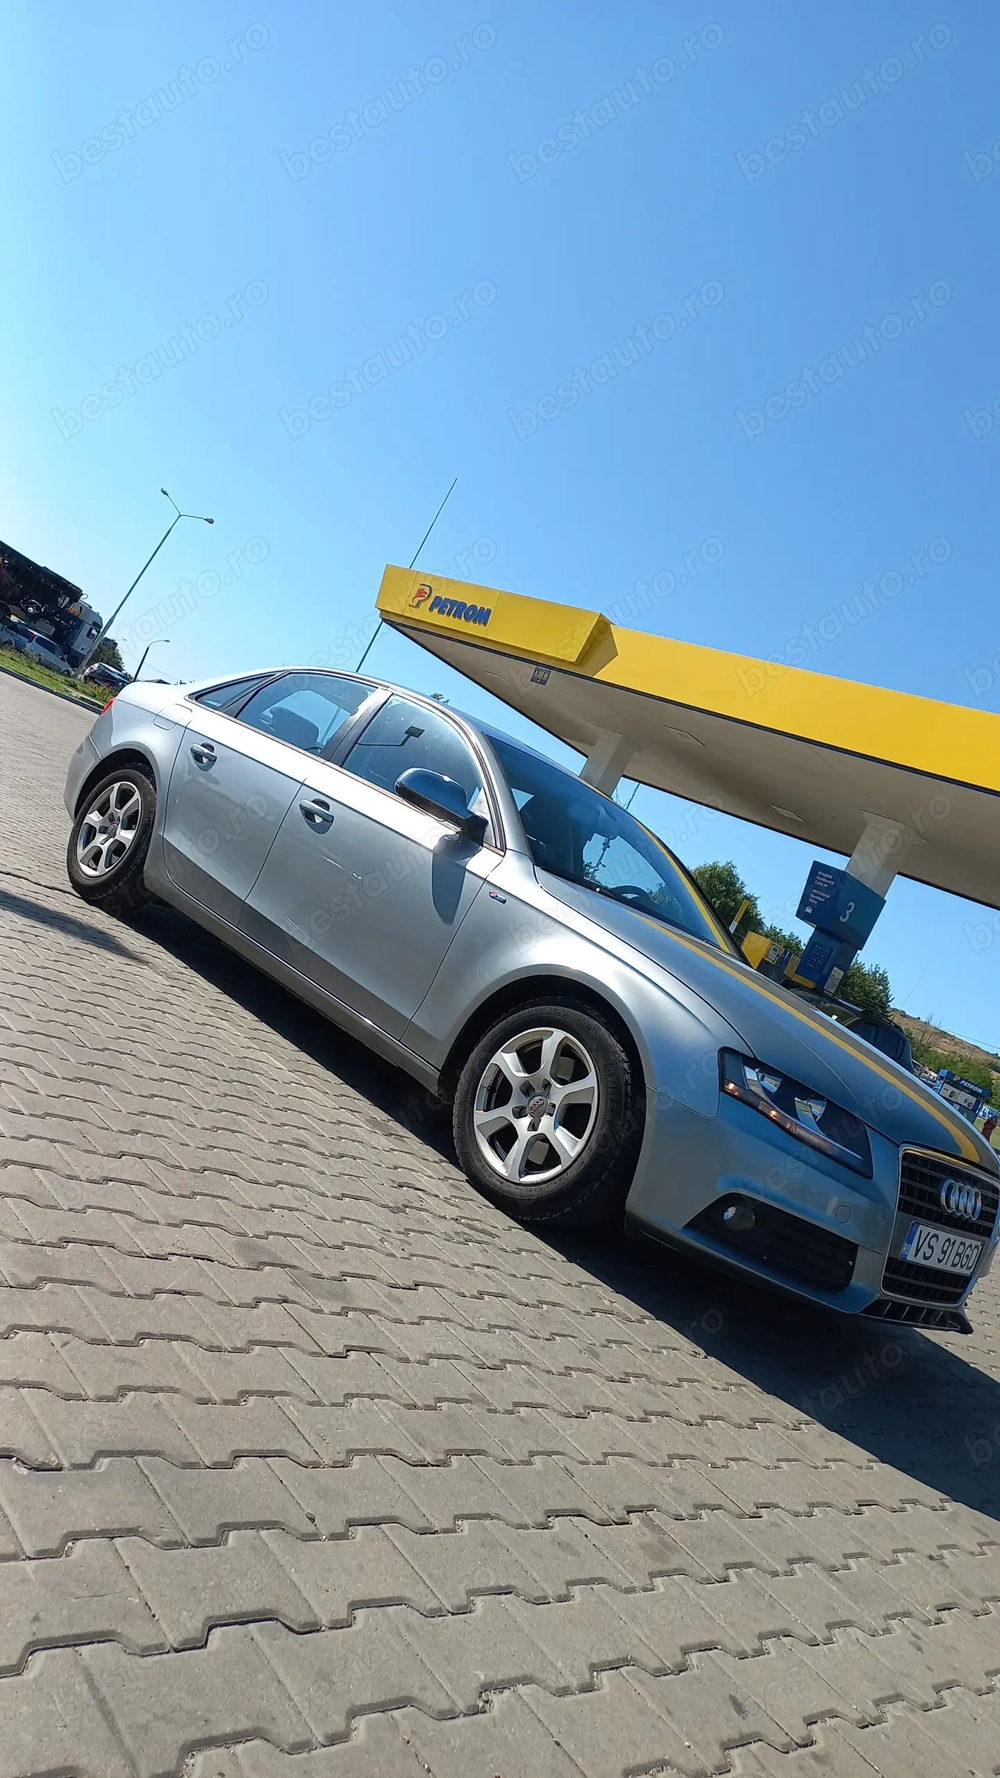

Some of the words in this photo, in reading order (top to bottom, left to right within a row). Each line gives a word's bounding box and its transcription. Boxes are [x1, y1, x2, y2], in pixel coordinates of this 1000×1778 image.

[429, 595, 492, 627] PETROM
[839, 902, 855, 923] 3
[960, 1080, 983, 1094] PETROM
[914, 1229, 939, 1261] VS
[937, 1237, 957, 1267] 91
[951, 1240, 980, 1271] BGD
